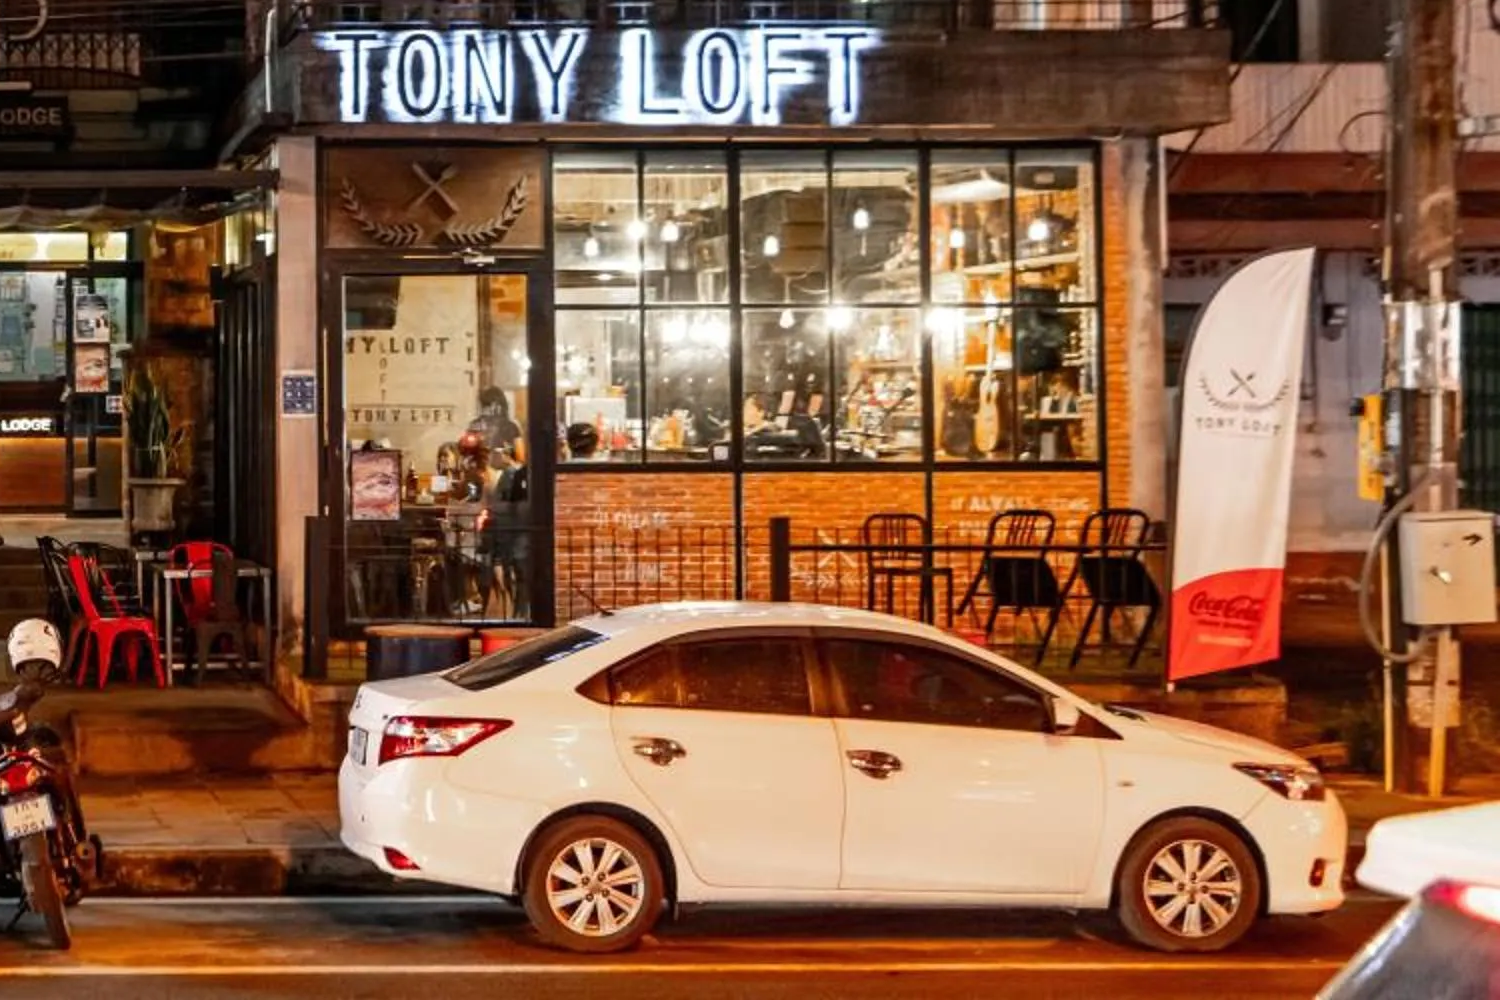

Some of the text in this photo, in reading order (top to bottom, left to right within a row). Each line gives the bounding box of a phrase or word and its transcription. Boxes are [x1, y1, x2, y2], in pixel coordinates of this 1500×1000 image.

[335, 31, 869, 117] TONY LOFT
[0, 417, 53, 432] LODGE
